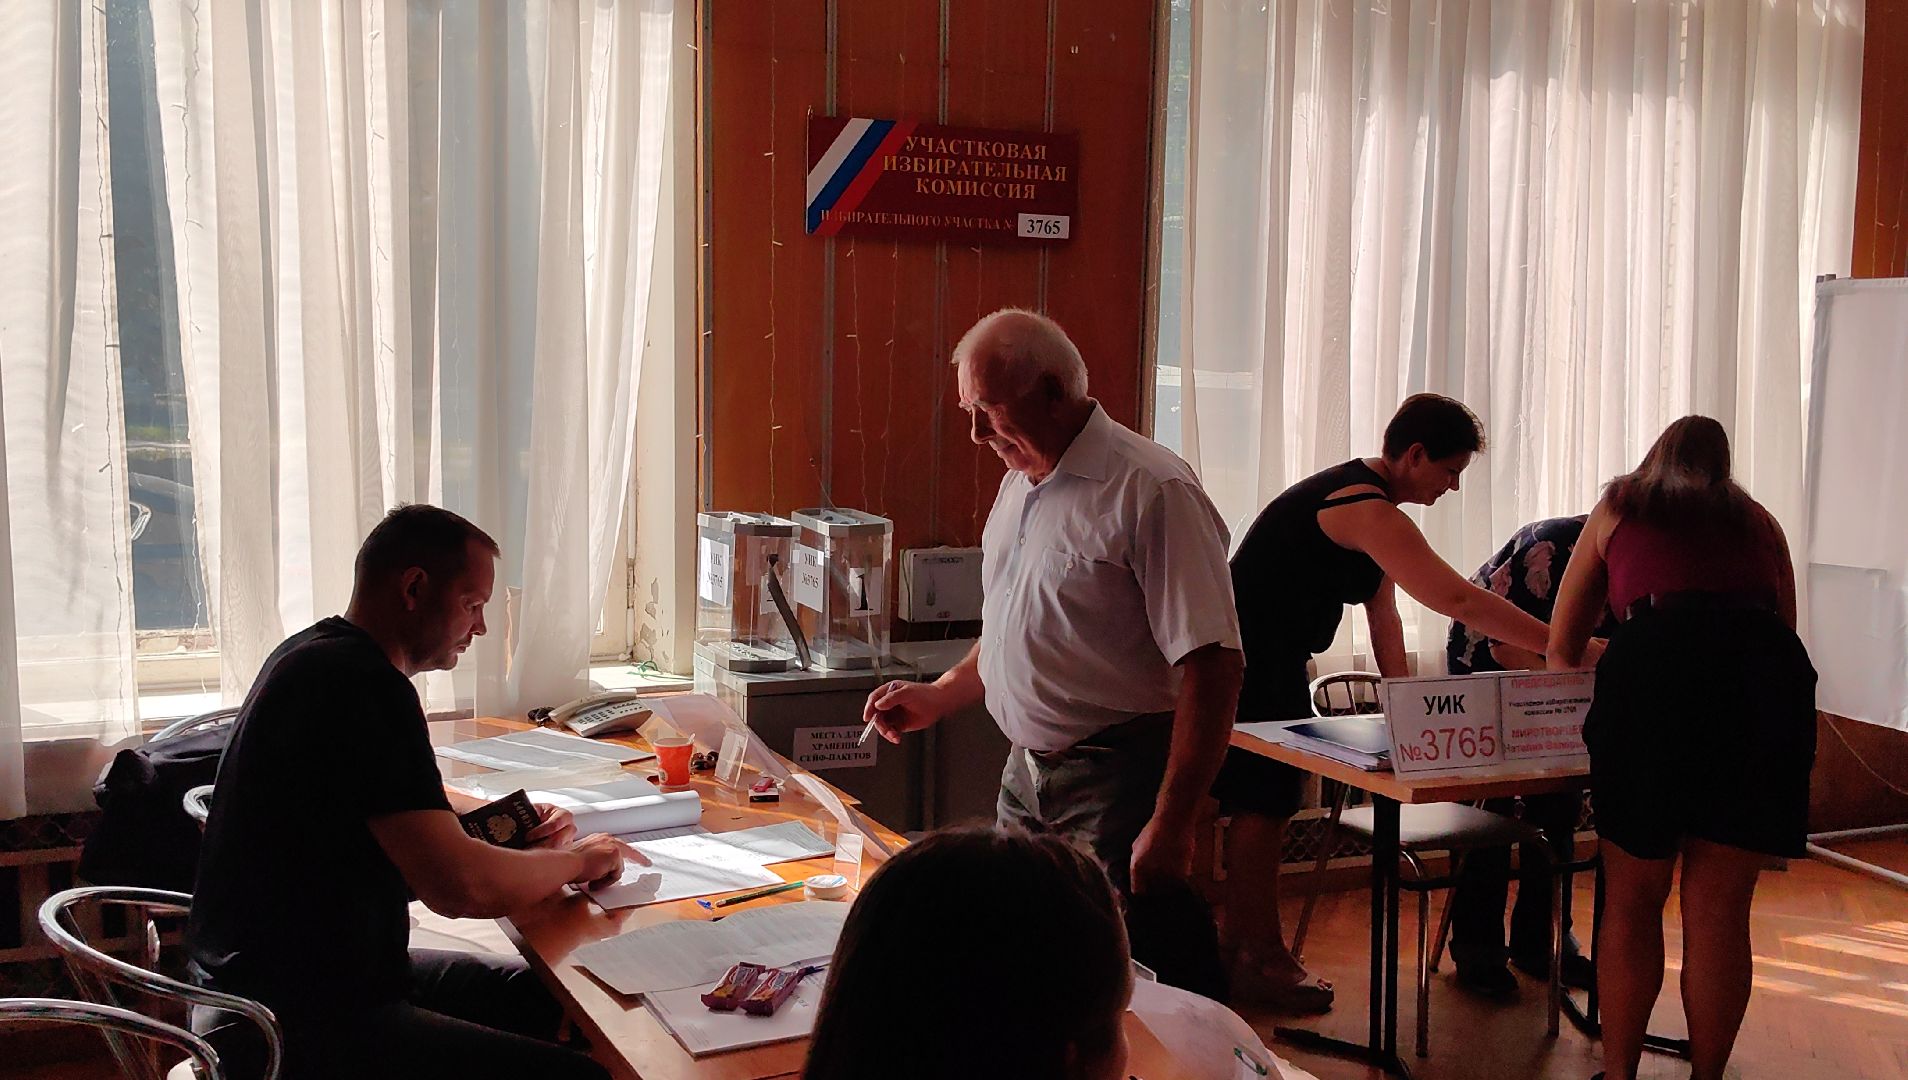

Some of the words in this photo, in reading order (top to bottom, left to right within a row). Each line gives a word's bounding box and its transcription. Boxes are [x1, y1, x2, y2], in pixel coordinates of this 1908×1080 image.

[905, 136, 1047, 160] УЧАСТКОВАЯ
[883, 155, 1068, 182] ИЗБИРАТЕЛЬНАЯ
[916, 178, 1037, 200] КОМИССИЯ
[821, 209, 942, 227] ИБИРАТЕЛЬНОГО
[944, 215, 1000, 230] УЧАСТКА
[1026, 219, 1061, 235] 3765
[1423, 694, 1466, 716] УИК
[811, 731, 842, 739] МЕСТА
[513, 800, 534, 828] АСПОРТ
